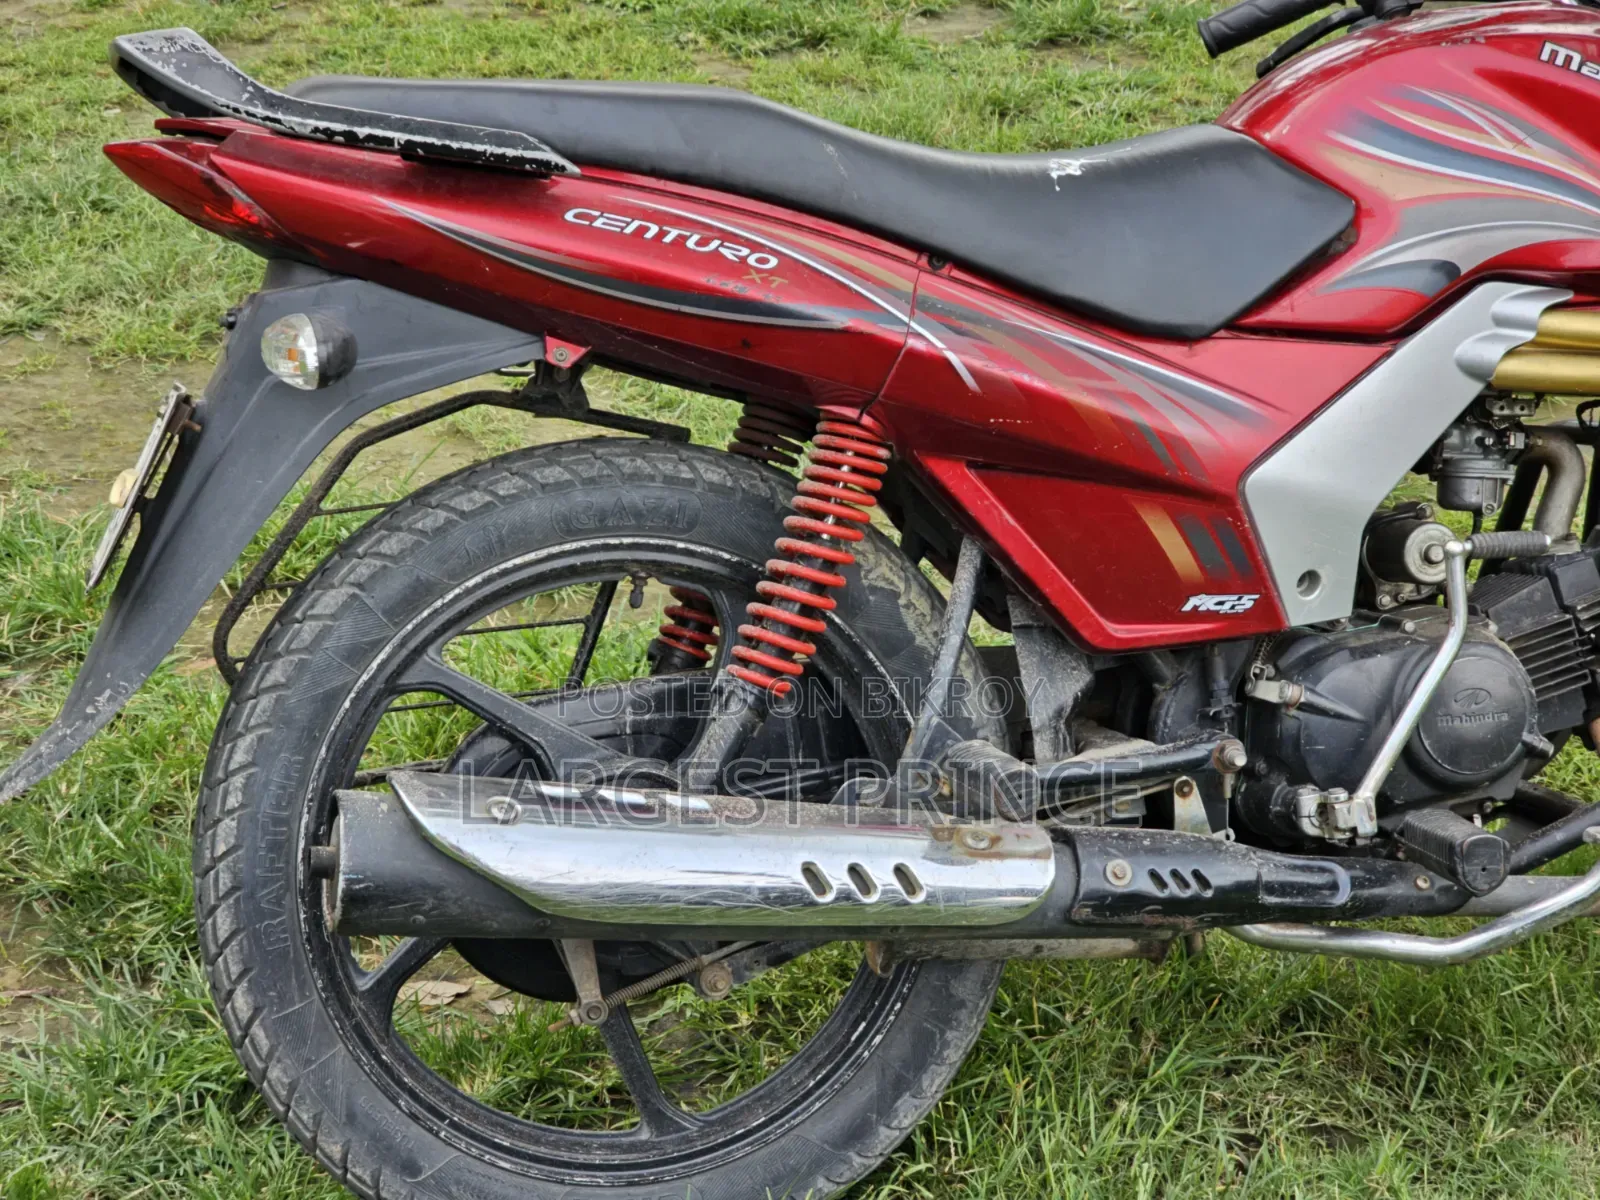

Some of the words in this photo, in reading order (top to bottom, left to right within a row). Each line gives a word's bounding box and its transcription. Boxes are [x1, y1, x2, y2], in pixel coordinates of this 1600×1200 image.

[563, 207, 779, 270] CENTURO
[742, 268, 788, 289] XT
[569, 496, 689, 530] GAZI
